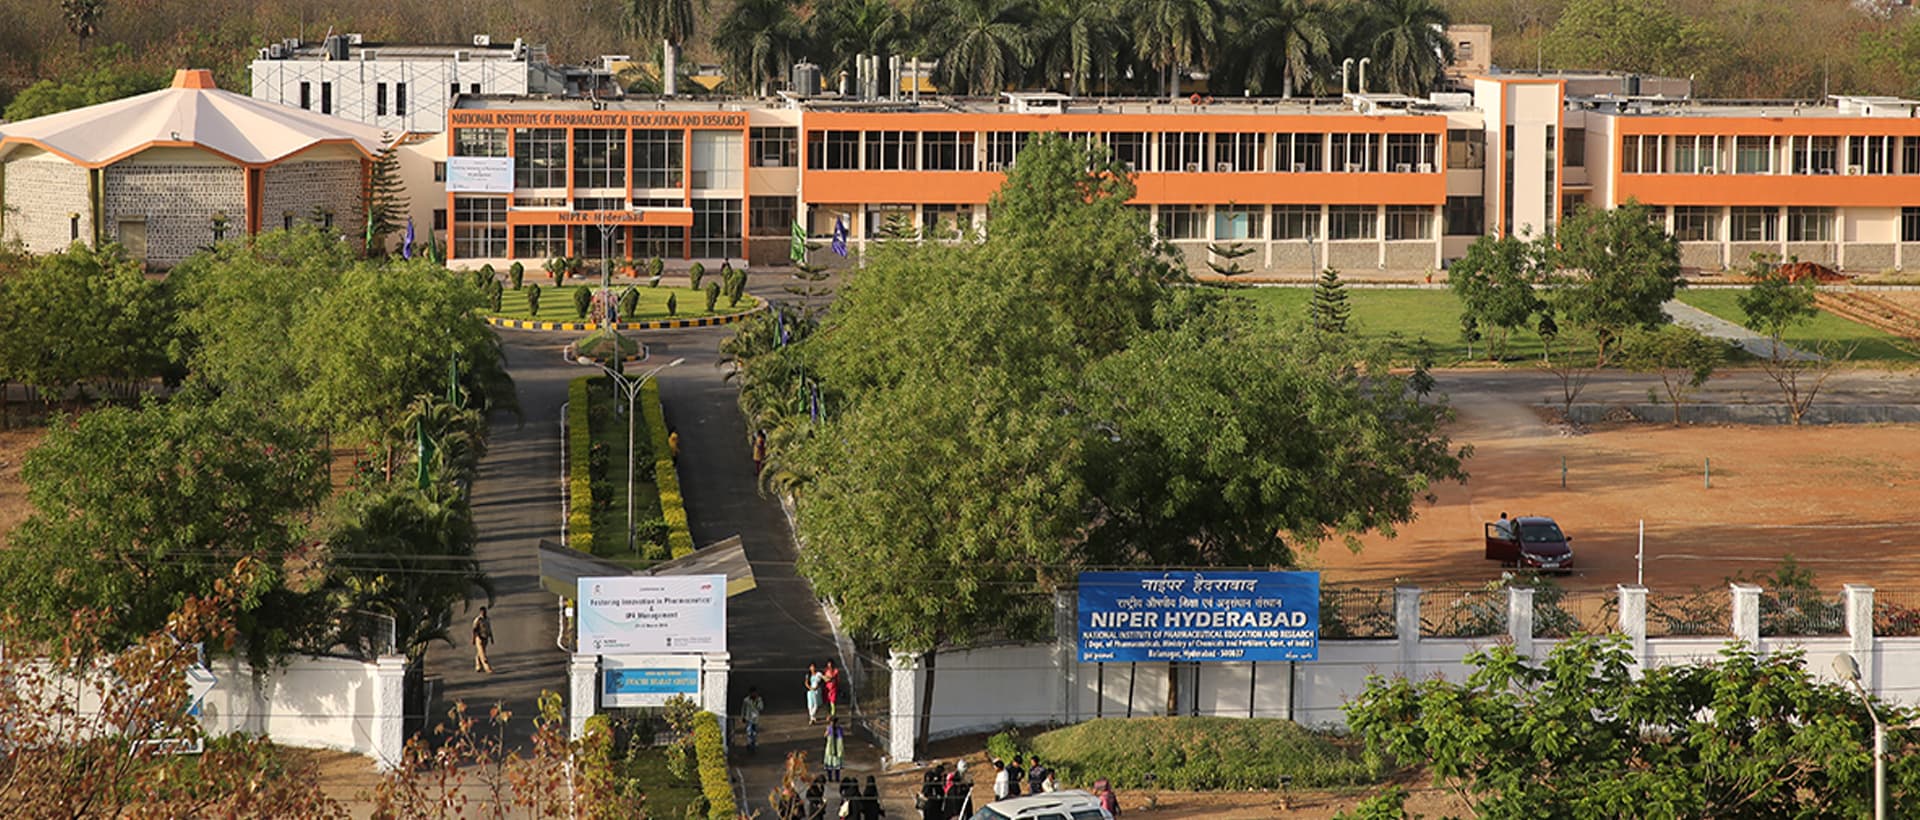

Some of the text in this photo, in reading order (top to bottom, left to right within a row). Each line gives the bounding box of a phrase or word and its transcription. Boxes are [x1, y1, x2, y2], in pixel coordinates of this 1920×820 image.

[452, 113, 745, 126] NATIONAL INSTITUTE OF PHARMACEUTICAL EDUCATION AND RESEARCH
[1141, 573, 1258, 594] नाईपर हैदराबाद
[1091, 612, 1307, 628] NIPER HYDERABAD
[1083, 630, 1314, 639] NATIONAL INSTITUTE OF PHARMACEUTICAL EDUCATION AND RESEARCH
